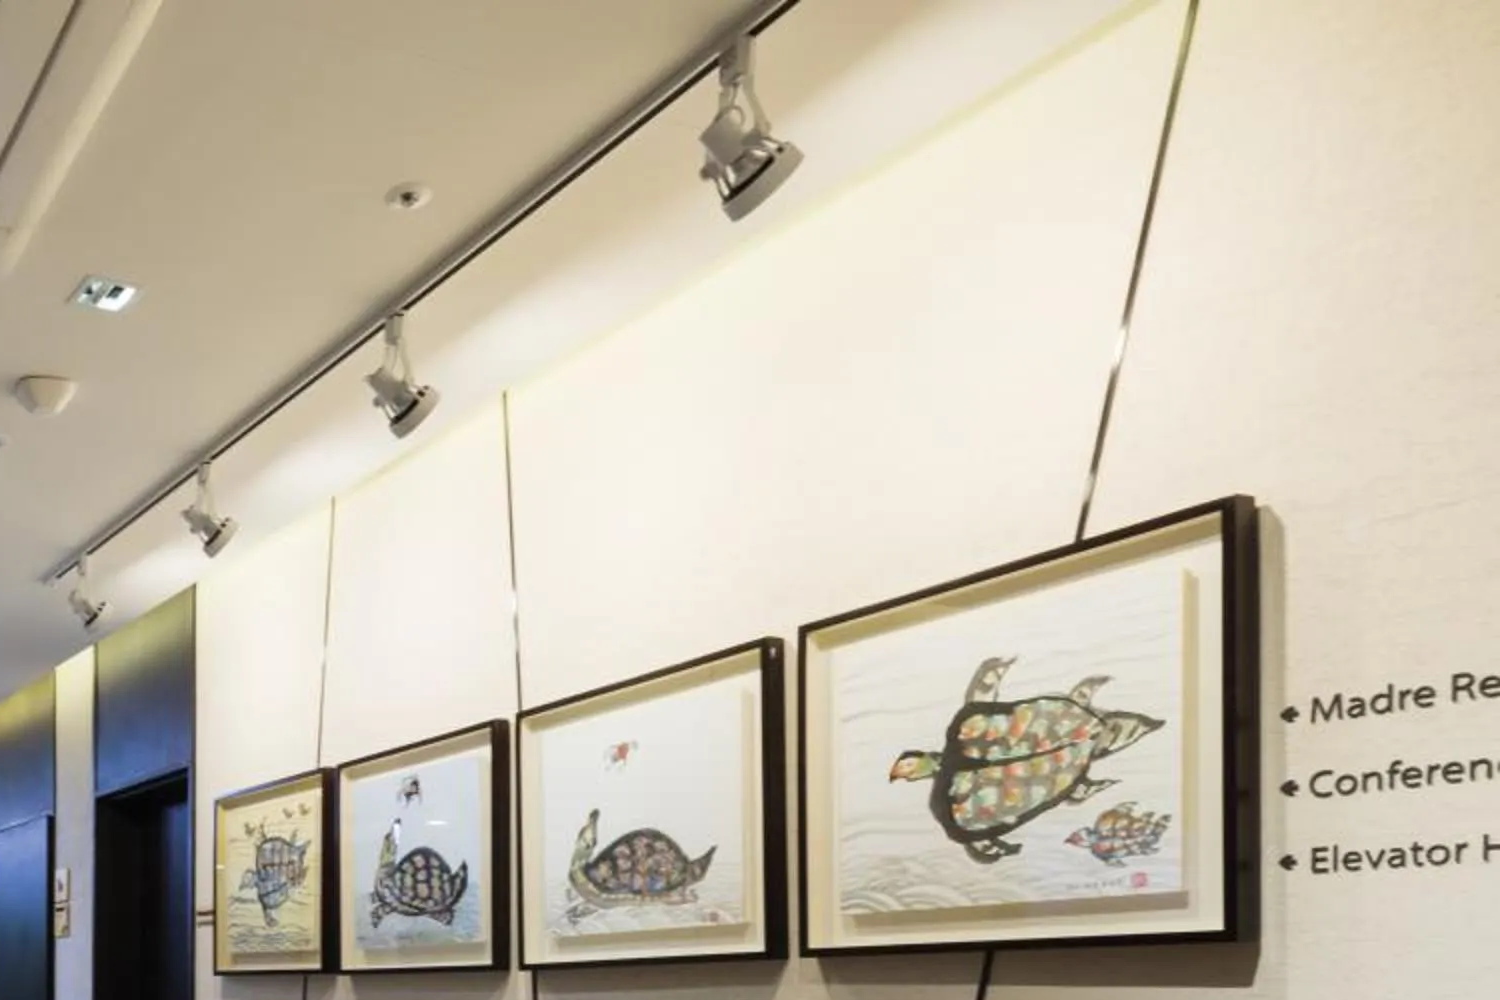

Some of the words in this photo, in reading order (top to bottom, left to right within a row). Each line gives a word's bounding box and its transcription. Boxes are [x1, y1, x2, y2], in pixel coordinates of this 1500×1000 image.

[1310, 683, 1436, 724] Madre
[1451, 672, 1500, 703] Re
[1309, 757, 1500, 799] Conferen
[1310, 842, 1468, 874] Elevator
